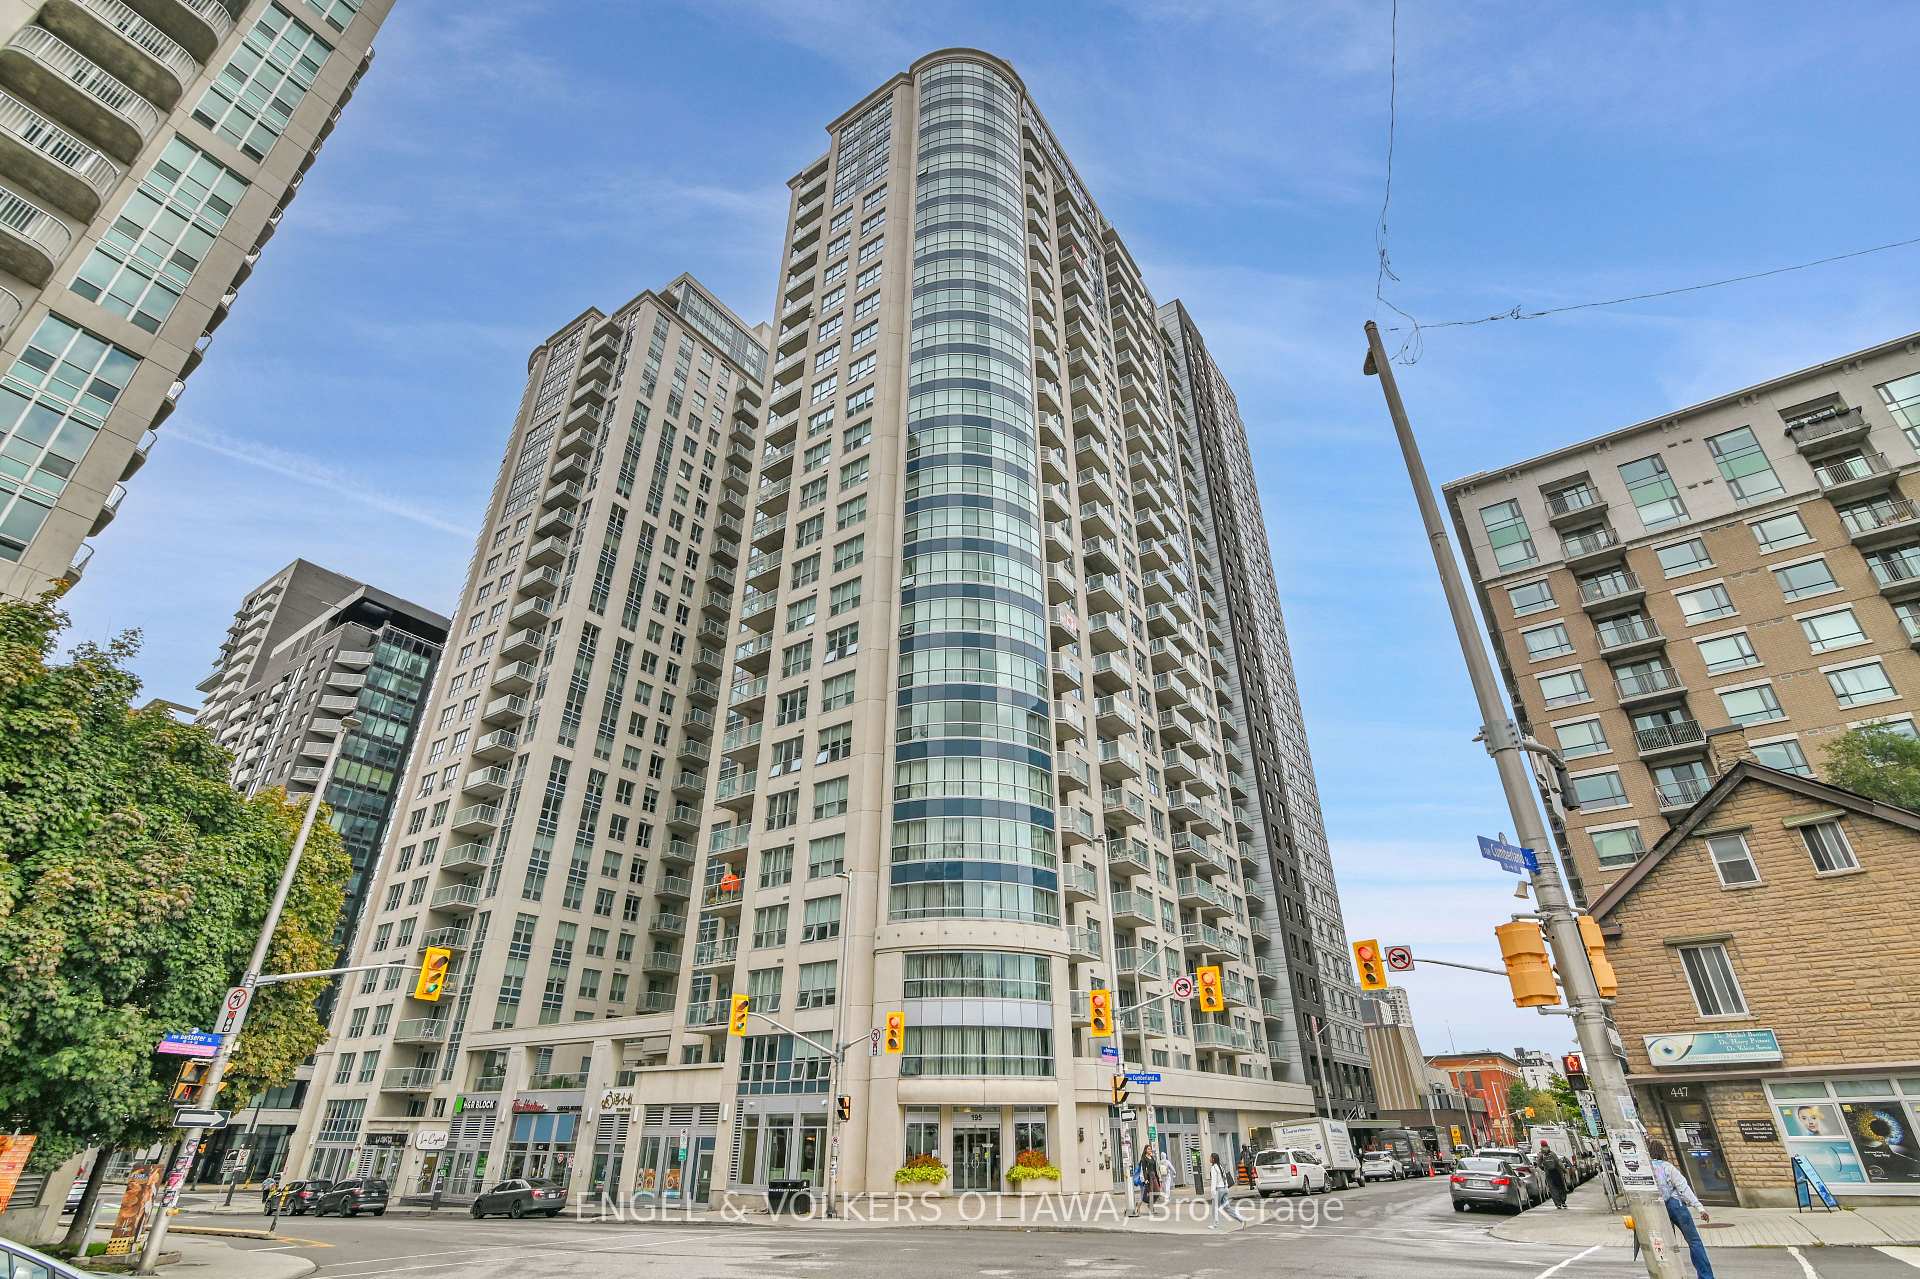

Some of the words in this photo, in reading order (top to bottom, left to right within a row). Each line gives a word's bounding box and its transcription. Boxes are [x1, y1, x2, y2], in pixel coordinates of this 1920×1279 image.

[1670, 1086, 1689, 1098] 447
[463, 1100, 476, 1110] H&R
[475, 1100, 495, 1110] BLOCK
